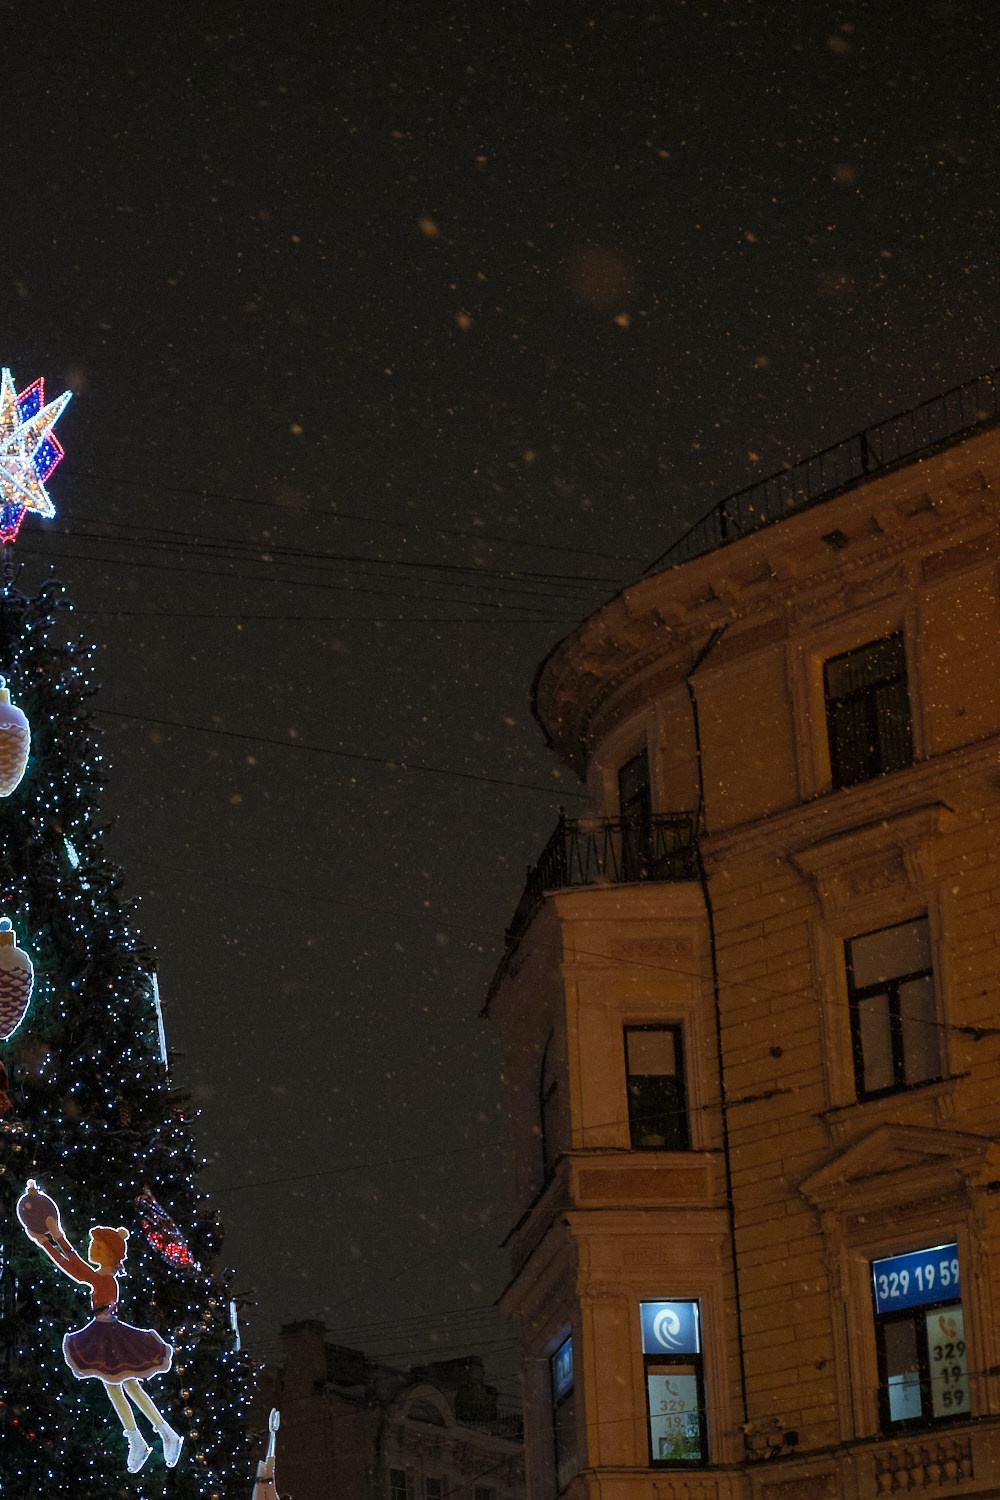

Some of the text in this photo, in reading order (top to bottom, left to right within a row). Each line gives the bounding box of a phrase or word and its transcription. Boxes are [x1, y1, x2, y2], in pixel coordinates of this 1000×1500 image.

[879, 1259, 960, 1299] 329 19 59
[934, 1341, 965, 1361] 329
[941, 1366, 962, 1385] 19
[660, 1400, 685, 1412] 329
[943, 1390, 964, 1408] 59
